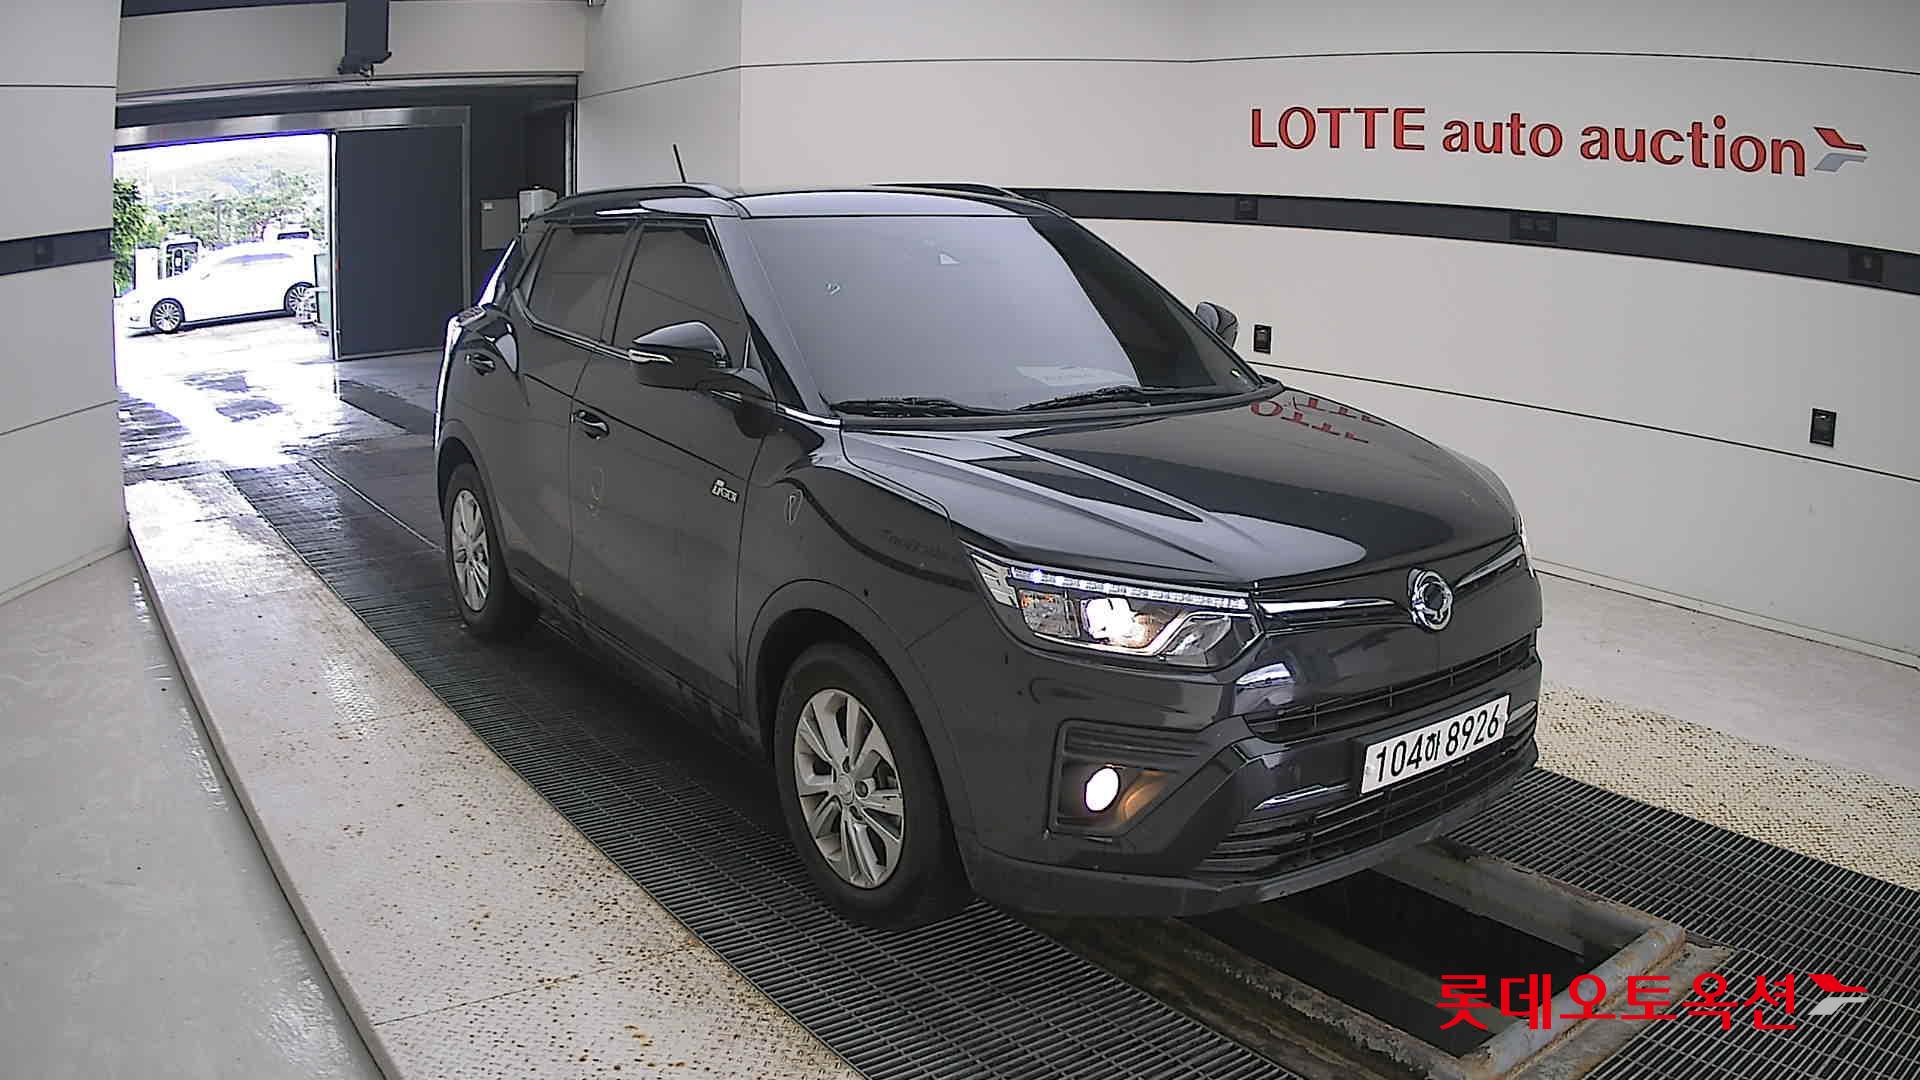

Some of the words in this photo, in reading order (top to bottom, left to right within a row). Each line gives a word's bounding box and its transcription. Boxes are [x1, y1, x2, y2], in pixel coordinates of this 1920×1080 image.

[1250, 106, 1426, 151] LOTTE
[1441, 113, 1564, 158] auto
[1580, 115, 1807, 177] auction
[1376, 730, 1441, 782] 104하
[1445, 703, 1500, 757] 8926
